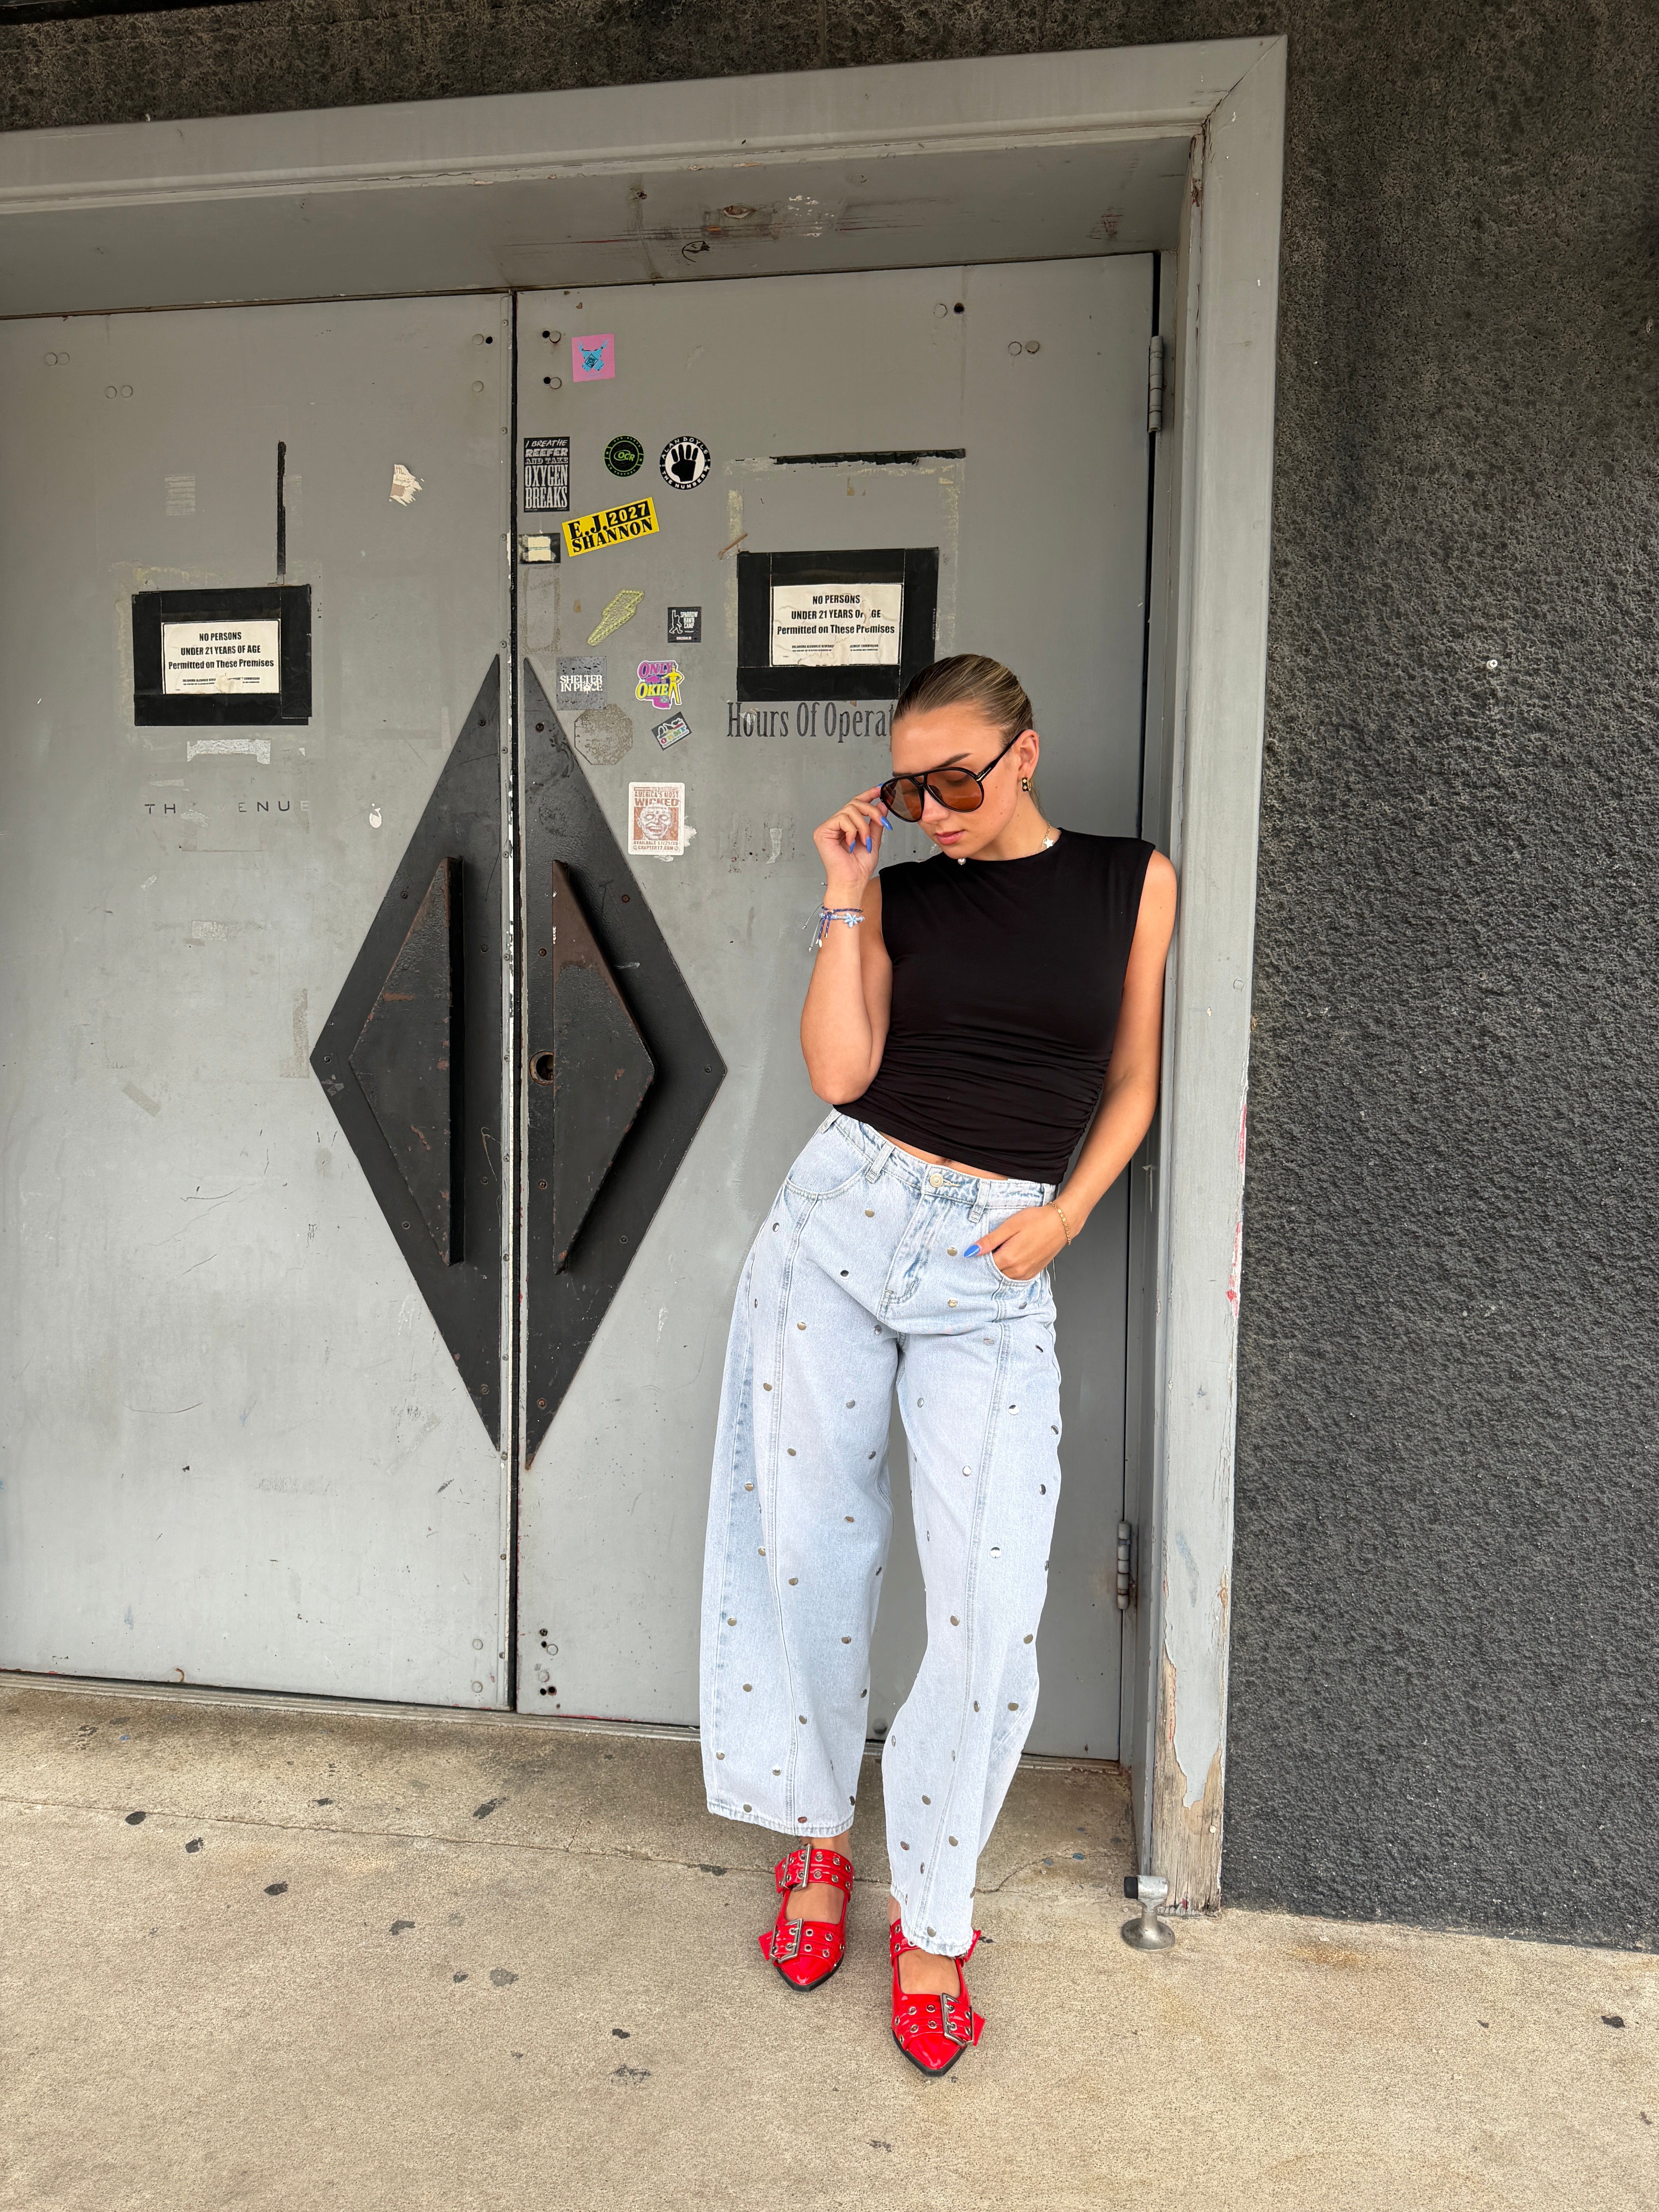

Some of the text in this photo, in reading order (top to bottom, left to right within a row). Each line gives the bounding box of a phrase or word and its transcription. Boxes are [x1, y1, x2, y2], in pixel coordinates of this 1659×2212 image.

[531, 439, 568, 447] BREATHE
[661, 438, 680, 459] ALAN
[683, 437, 709, 454] DOYLE
[525, 448, 568, 457] REEFER
[618, 452, 635, 461] OCR
[525, 464, 568, 487] OXYGEN
[662, 471, 673, 484] THE
[675, 474, 706, 489] NUMBER
[525, 486, 568, 509] BREAKS
[567, 503, 646, 540] E.J. 2027
[572, 518, 653, 553] SHANNON
[813, 595, 860, 605] NO PERSONS
[792, 611, 817, 620] UNDER
[819, 610, 827, 619] 21
[829, 610, 853, 619] YEARS
[869, 609, 881, 618] GE
[777, 625, 817, 635] Permitted
[830, 624, 854, 634] These
[856, 624, 895, 634] Premises
[199, 632, 242, 641] NO PERSONS
[181, 645, 261, 656] UNDER 21 YEARS OF AGE
[168, 661, 204, 670] Permitted
[216, 659, 237, 668] These
[239, 659, 274, 667] Premises
[638, 662, 673, 678] ONLY
[560, 675, 603, 684] SHELTER
[561, 683, 572, 692] IN
[637, 682, 668, 699] OKIE
[727, 702, 894, 743] Hours Of Operat
[634, 798, 679, 806] WICKED
